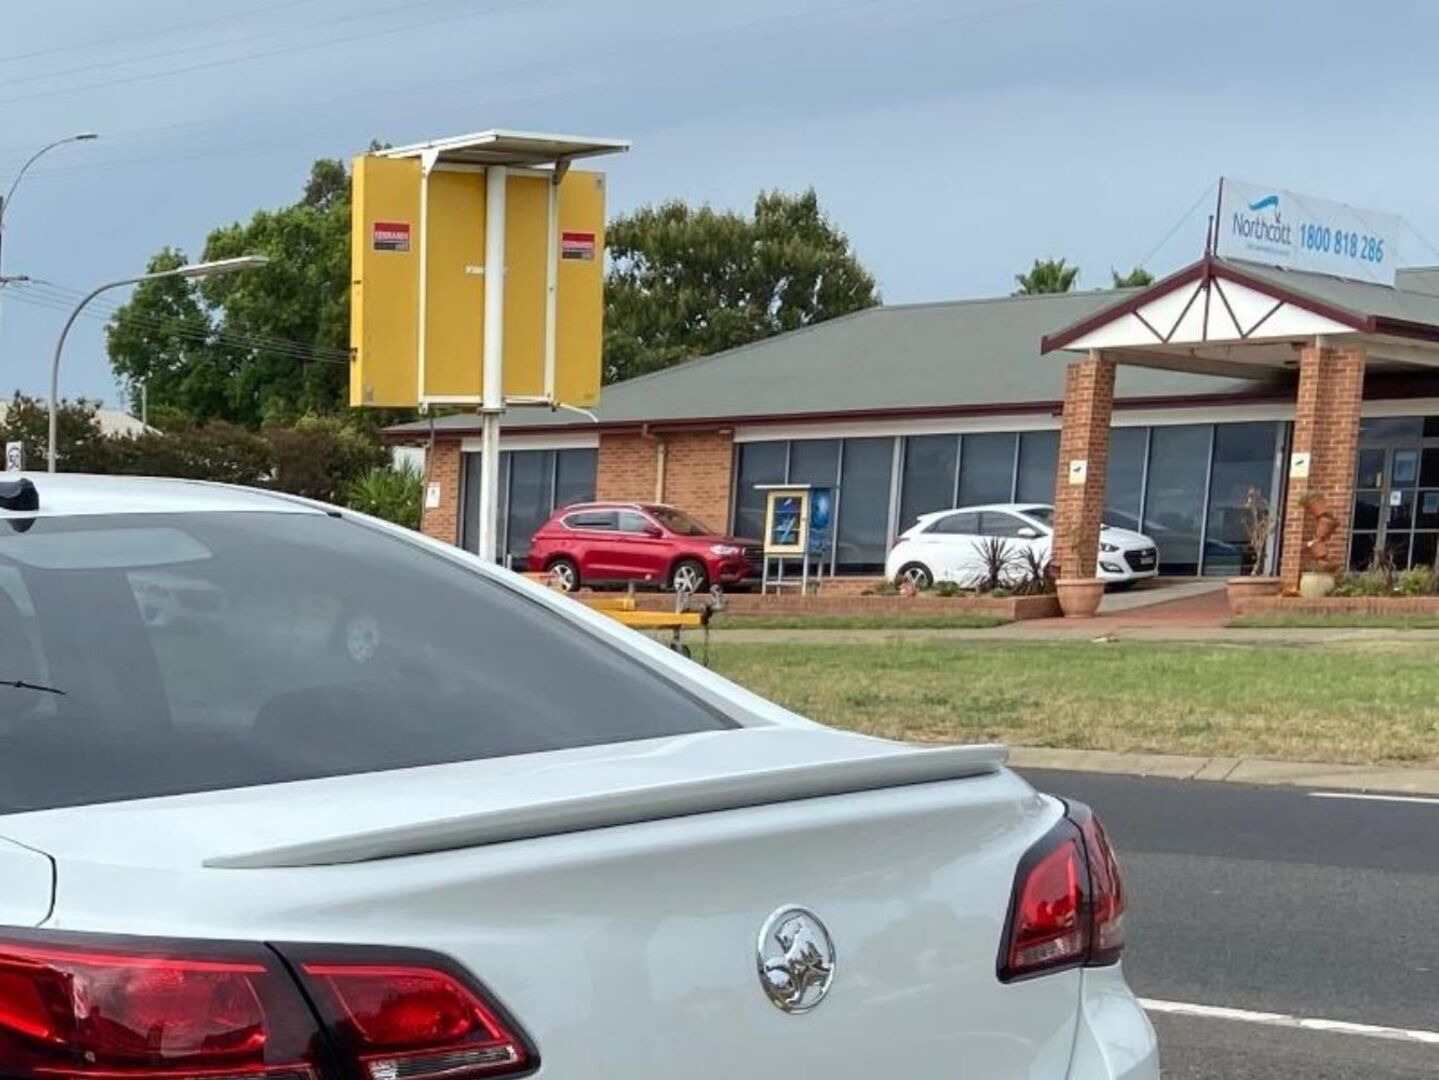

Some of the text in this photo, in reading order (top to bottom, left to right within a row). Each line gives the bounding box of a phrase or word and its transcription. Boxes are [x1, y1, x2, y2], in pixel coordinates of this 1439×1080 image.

[1232, 212, 1292, 246] Northcott
[1299, 222, 1332, 254] 1800
[1333, 229, 1358, 258] 818
[1360, 235, 1385, 263] 286
